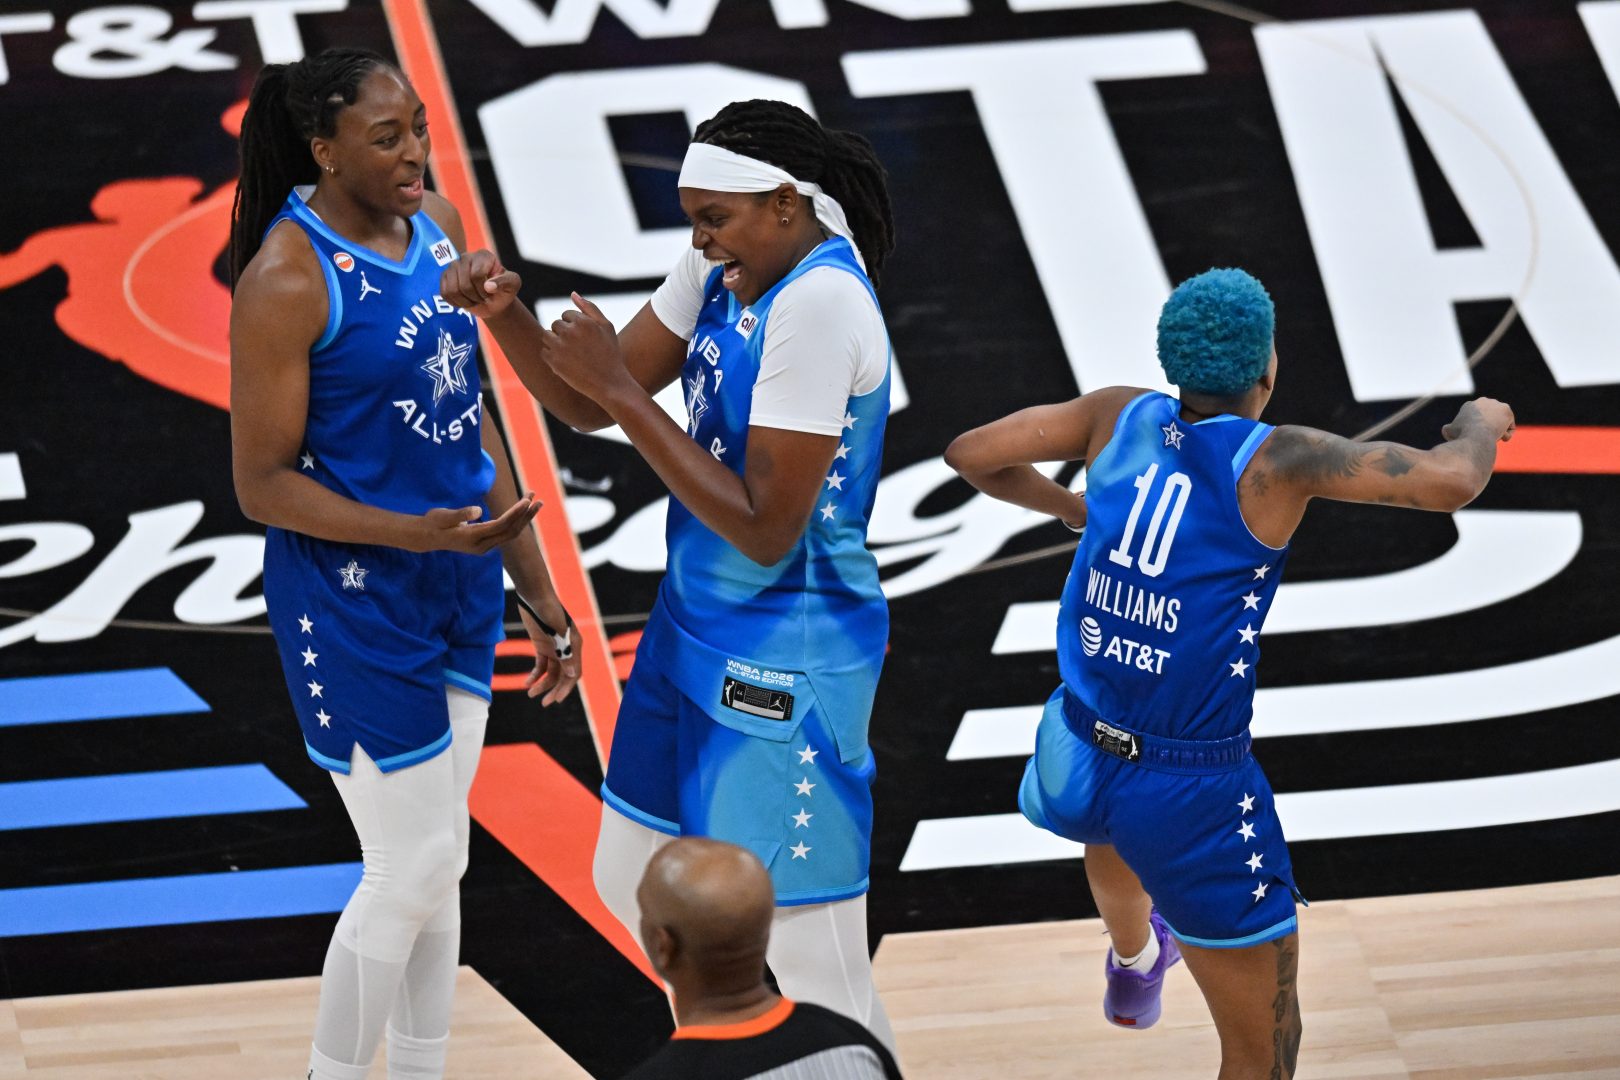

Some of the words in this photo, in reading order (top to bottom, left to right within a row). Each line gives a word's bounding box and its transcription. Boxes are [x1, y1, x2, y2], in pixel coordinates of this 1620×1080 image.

[434, 243, 453, 261] ally
[1108, 462, 1192, 578] 10
[1085, 566, 1181, 633] WILLIAMS
[727, 658, 760, 676] WNBA
[762, 670, 794, 682] 2026
[1103, 635, 1171, 675] AT&T
[726, 666, 760, 681] ALL-STAR
[761, 677, 794, 687] EDITION
